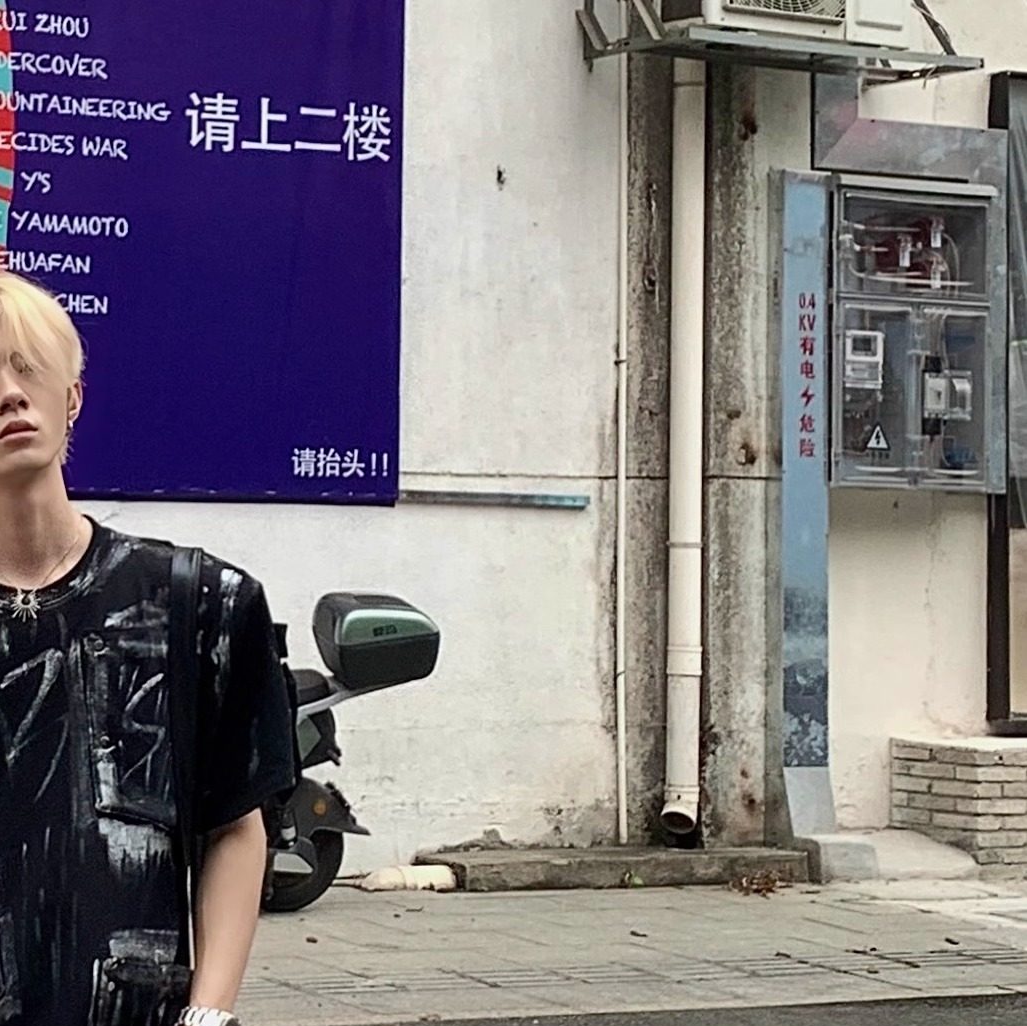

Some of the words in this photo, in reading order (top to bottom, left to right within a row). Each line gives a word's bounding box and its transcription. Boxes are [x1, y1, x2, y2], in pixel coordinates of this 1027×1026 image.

[34, 13, 90, 38] ZHOU
[185, 92, 391, 163] 请上二楼
[81, 136, 128, 160] WAR
[20, 171, 51, 194] Y'S
[11, 210, 129, 237] YAMAMOTO
